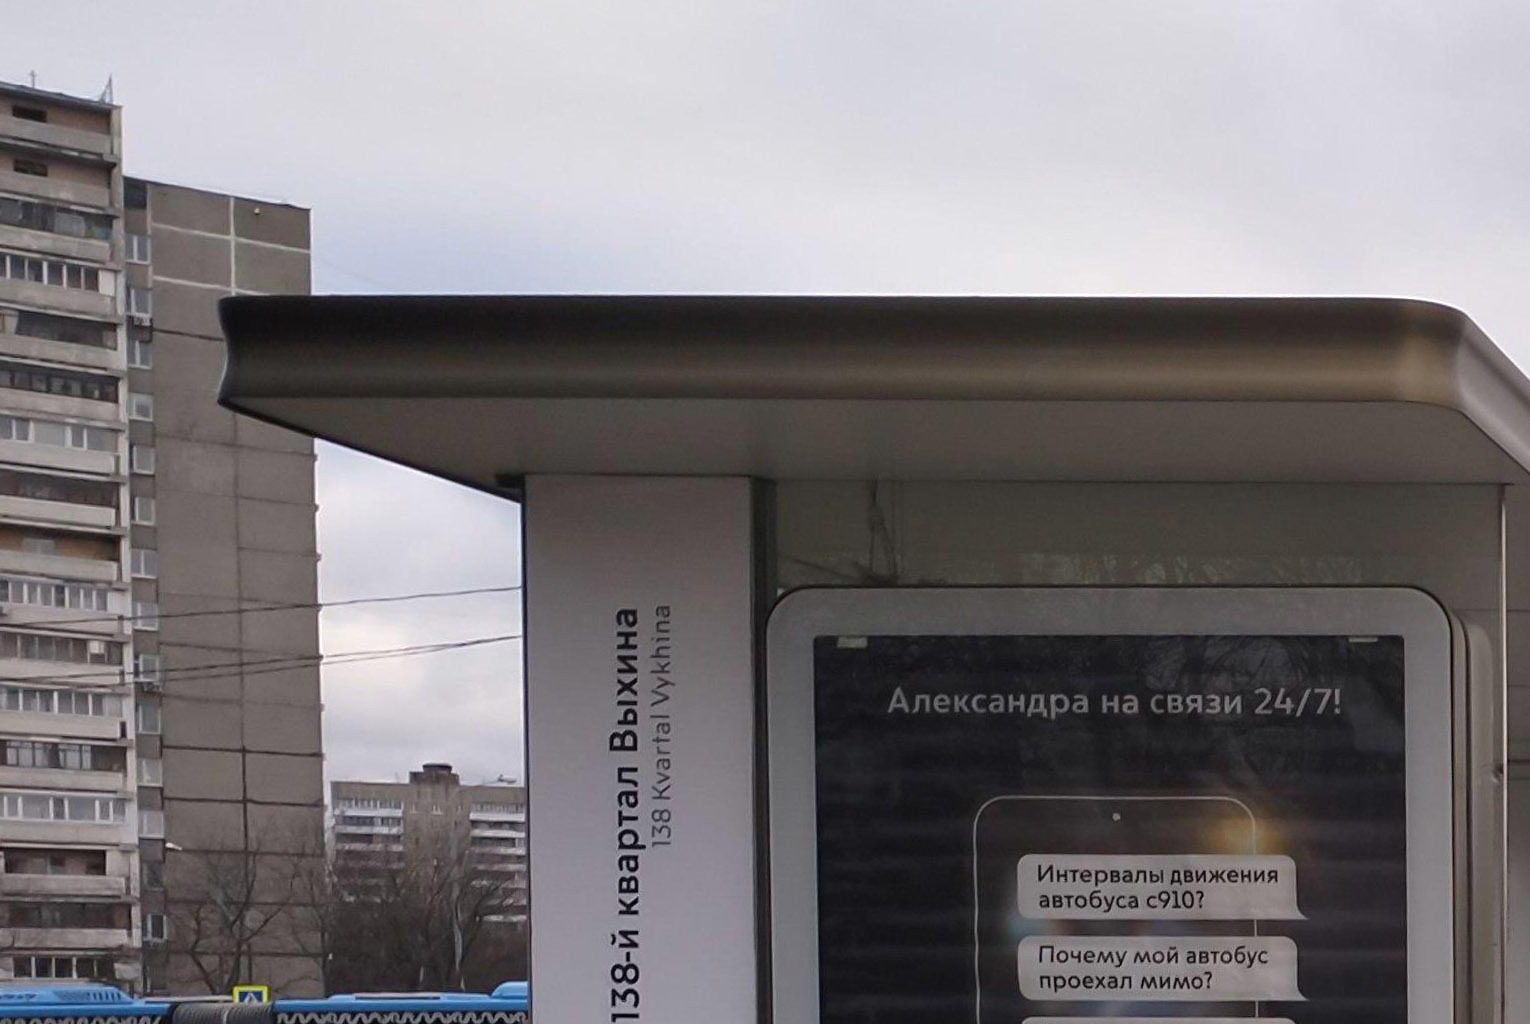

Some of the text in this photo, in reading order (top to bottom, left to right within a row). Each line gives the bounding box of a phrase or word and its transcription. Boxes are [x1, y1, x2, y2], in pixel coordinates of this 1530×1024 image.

[888, 686, 1342, 719] Александра на связи 24/7!
[651, 605, 675, 847] 138 Kvartal Vykhina
[609, 608, 646, 1022] 138-й квартал Выхина
[1037, 865, 1279, 887] Интервалы движения
[1039, 890, 1205, 911] автобуса с910?
[1038, 946, 1268, 968] Почему мой автобус
[1039, 971, 1213, 993] проехал мимо?
